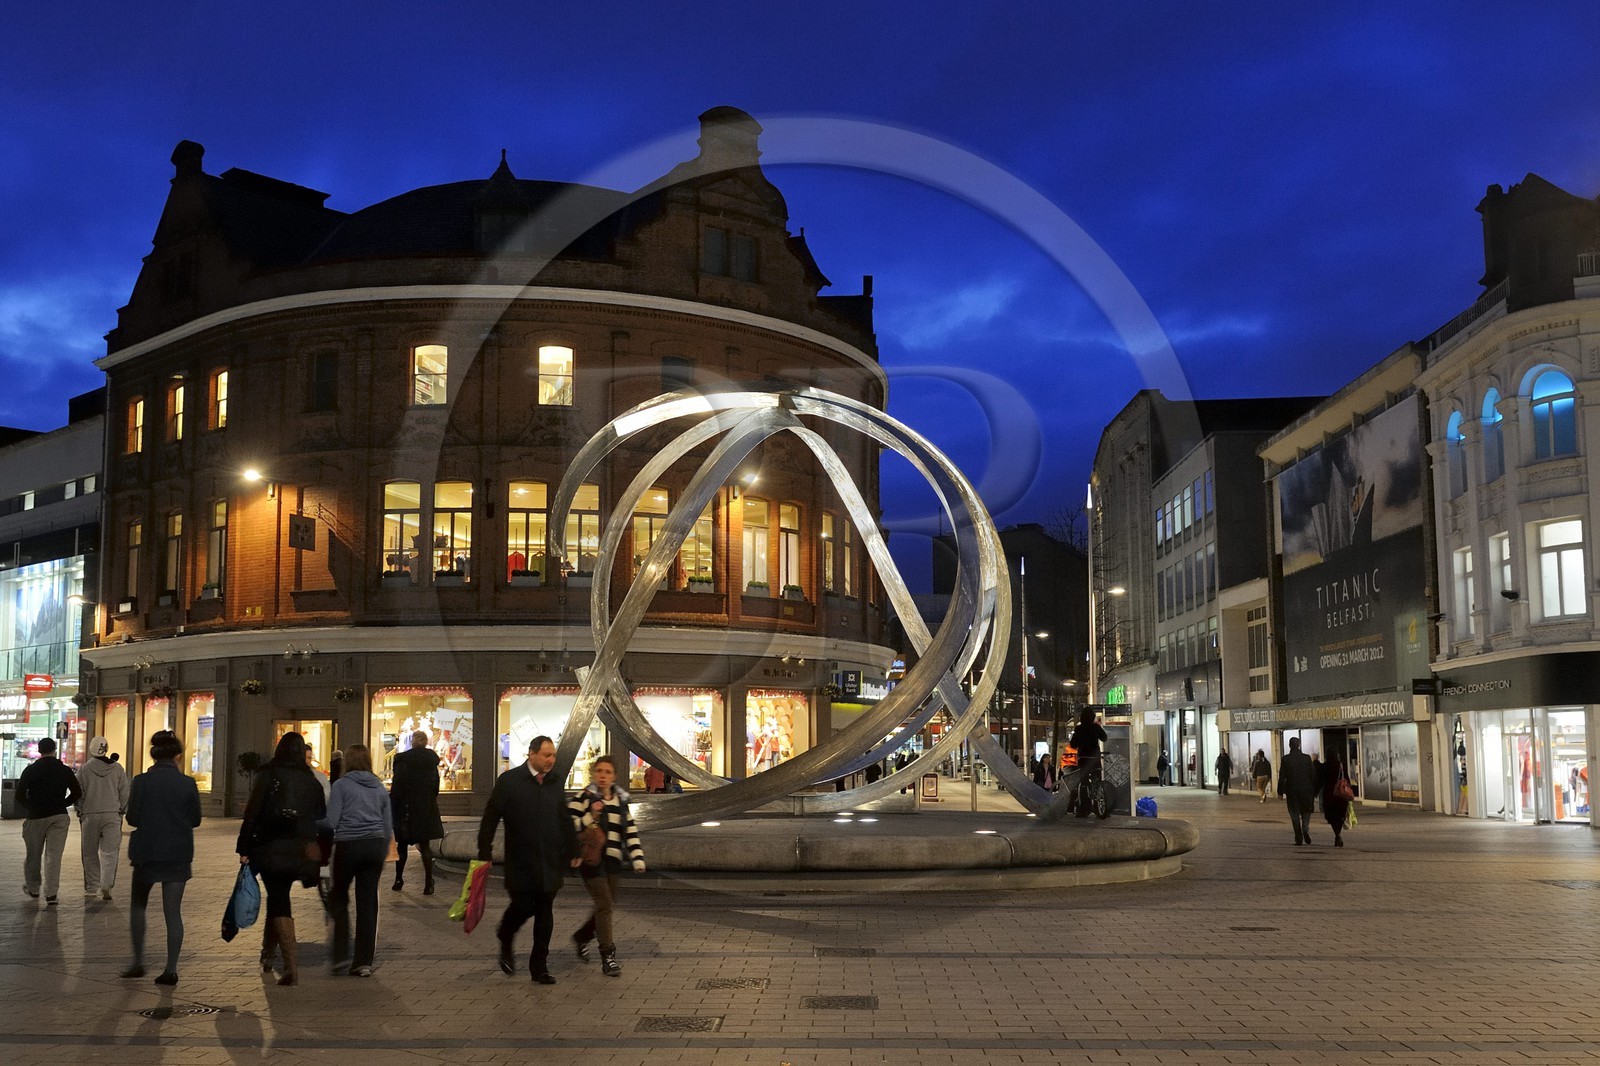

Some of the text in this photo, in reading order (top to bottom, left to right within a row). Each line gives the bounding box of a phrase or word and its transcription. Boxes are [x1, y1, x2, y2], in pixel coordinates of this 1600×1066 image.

[1316, 568, 1380, 609] TITANIC
[1326, 603, 1370, 629] BELFAST
[1320, 646, 1384, 669] OPENING 31 MARCH 2012
[1443, 685, 1466, 696] FRENCH
[1468, 680, 1510, 693] CONNECTION
[1341, 701, 1405, 719] TITANICBELFAST.COM
